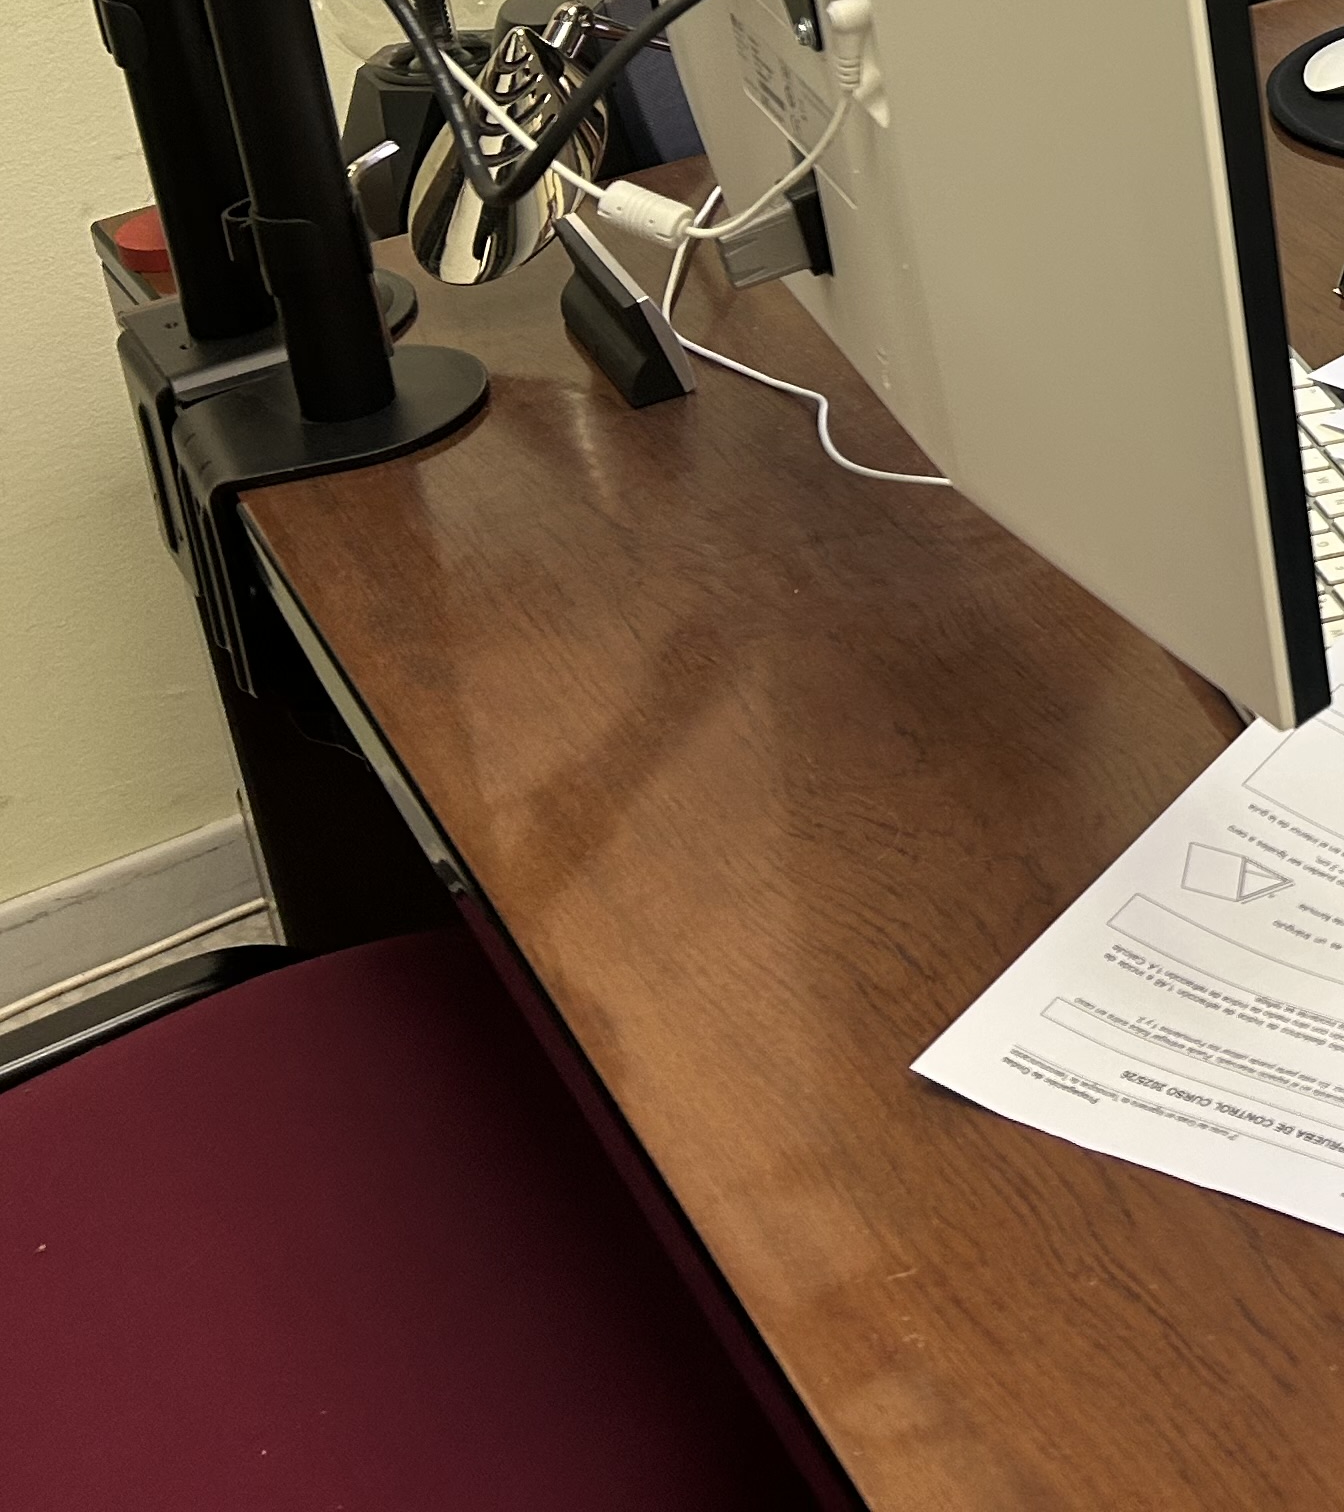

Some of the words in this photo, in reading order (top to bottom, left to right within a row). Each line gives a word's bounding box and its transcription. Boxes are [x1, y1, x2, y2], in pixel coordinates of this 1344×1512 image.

[1165, 1087, 1213, 1108] CURSO
[1214, 1102, 1275, 1128] CONTROL
[1273, 1122, 1296, 1136] DE
